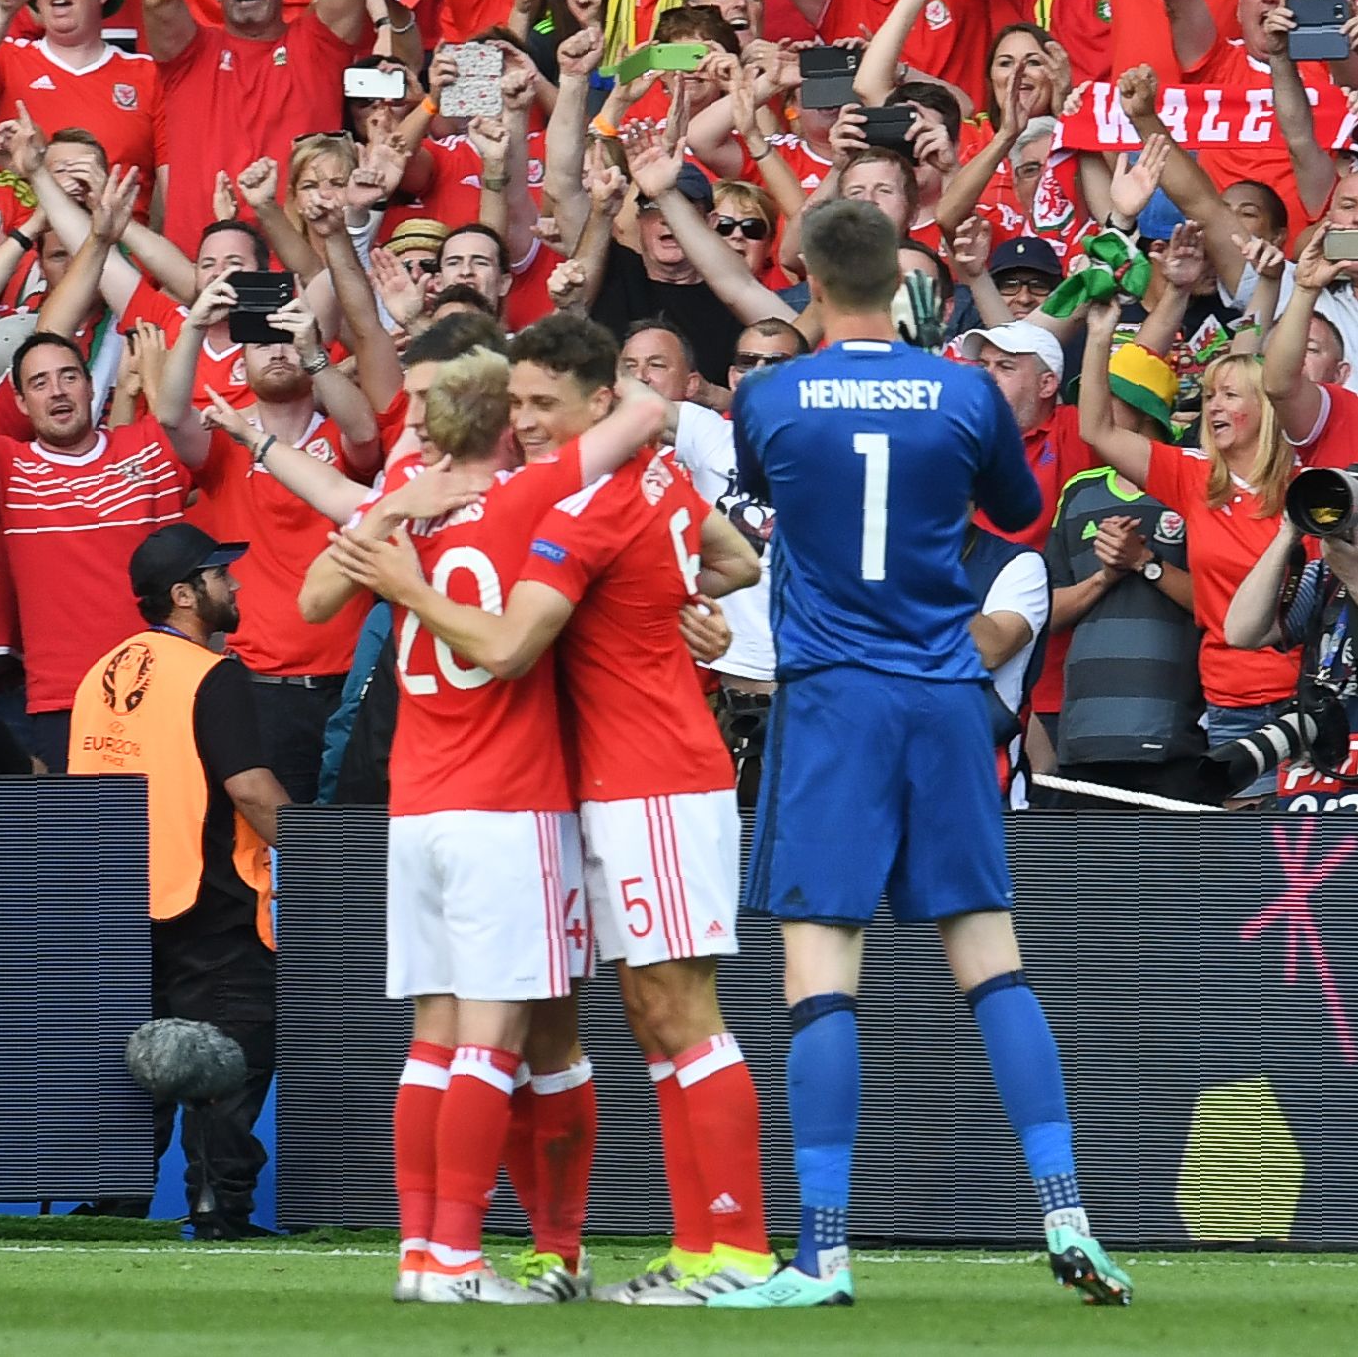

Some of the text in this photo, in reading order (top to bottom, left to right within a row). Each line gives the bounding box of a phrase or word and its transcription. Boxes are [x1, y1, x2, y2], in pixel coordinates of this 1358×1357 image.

[1091, 81, 1319, 144] WALE
[798, 378, 943, 411] HENNESSEY
[852, 433, 890, 582] 1
[620, 875, 654, 939] 5
